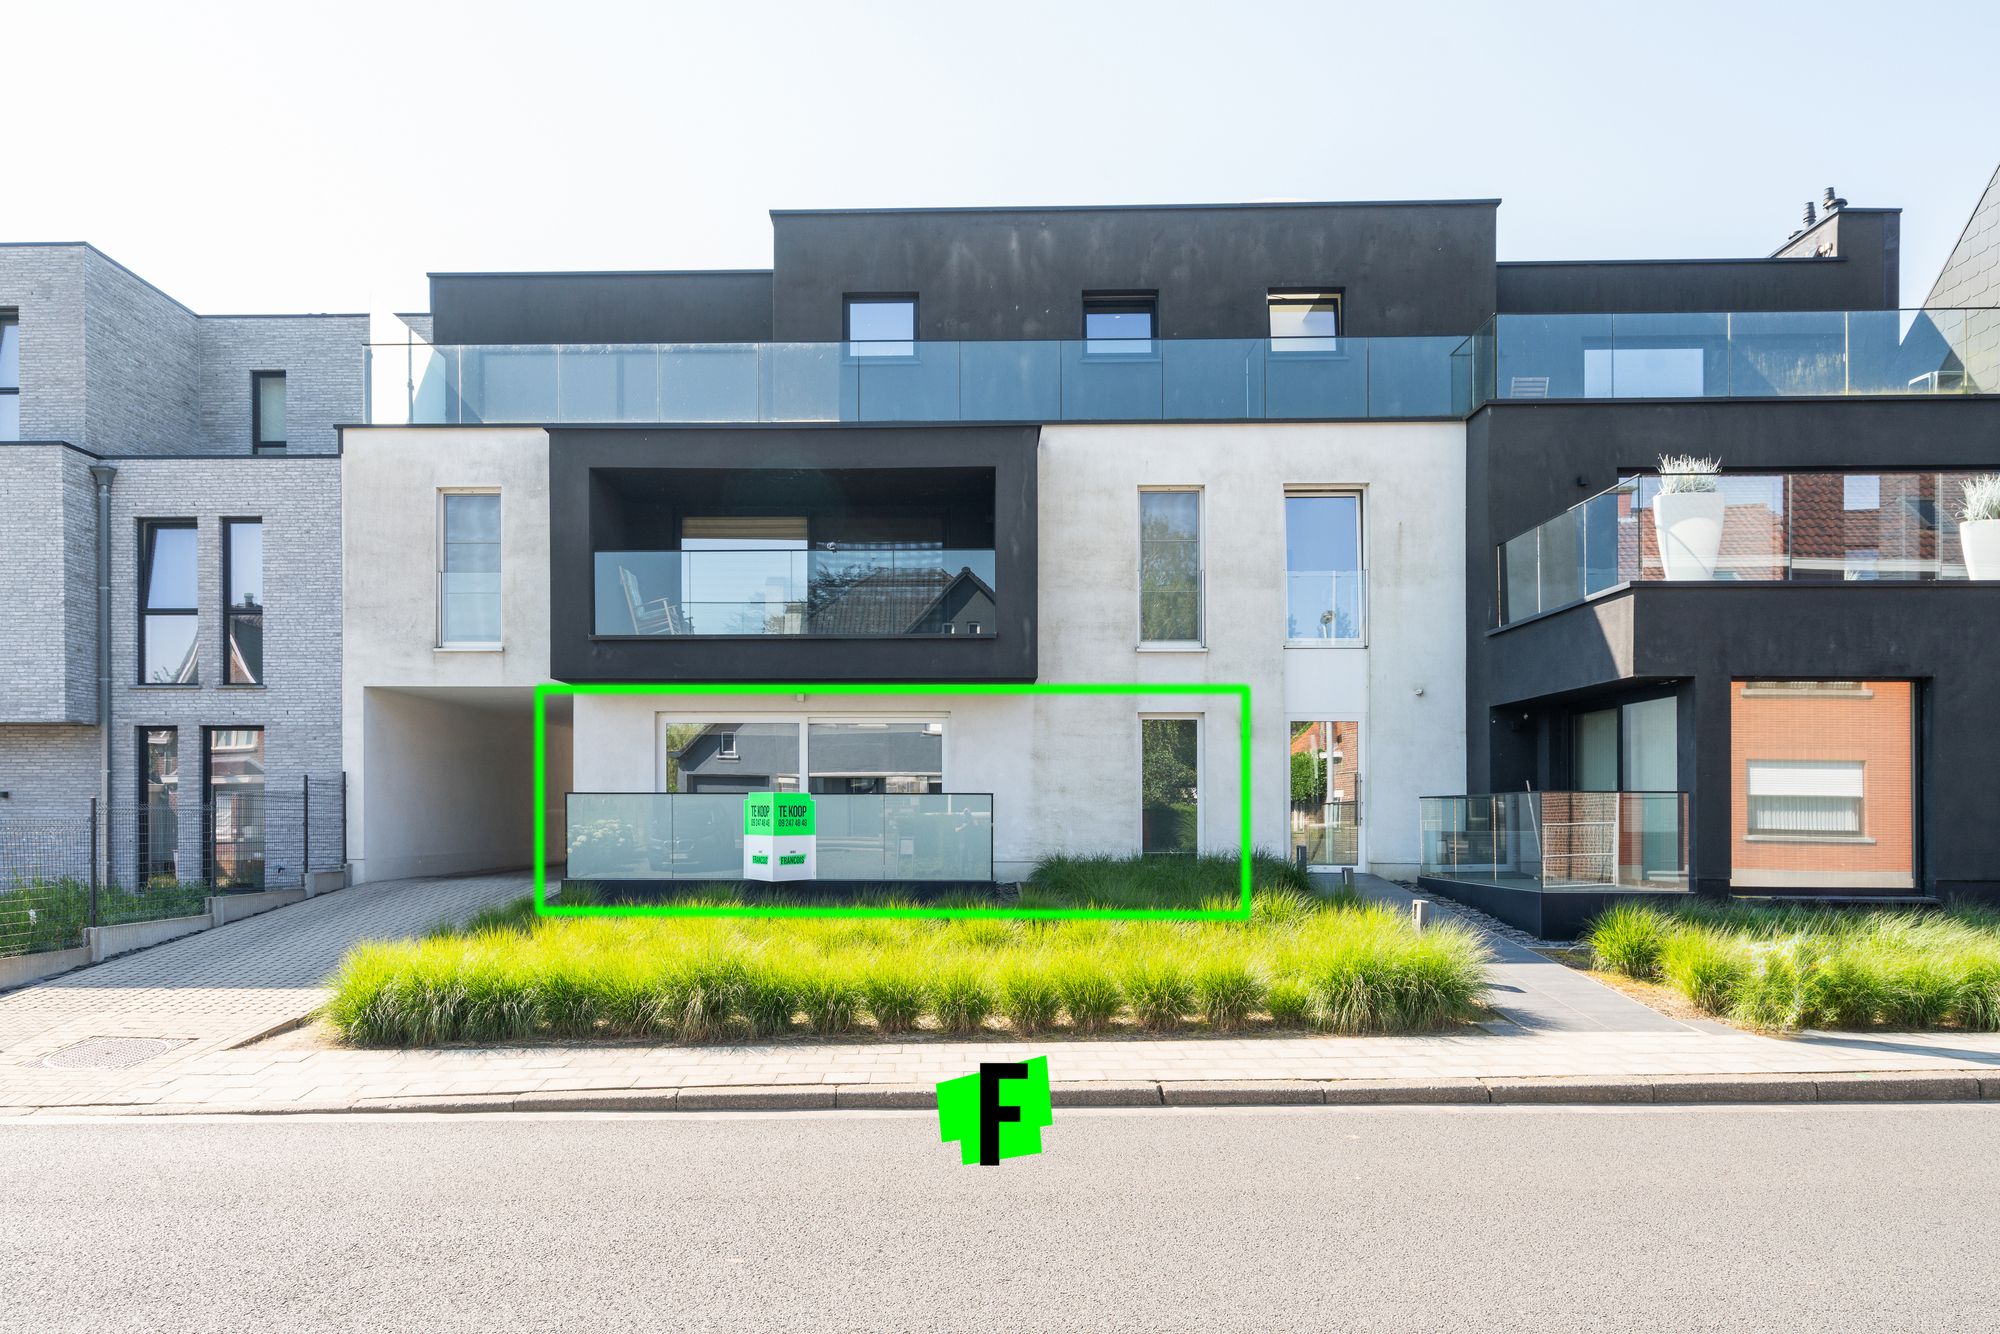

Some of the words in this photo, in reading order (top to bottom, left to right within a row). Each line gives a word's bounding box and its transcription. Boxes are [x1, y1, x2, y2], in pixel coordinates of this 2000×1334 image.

[751, 805, 756, 817] TE
[758, 805, 770, 817] KOOP
[778, 806, 787, 817] TE
[789, 806, 807, 817] KOOP
